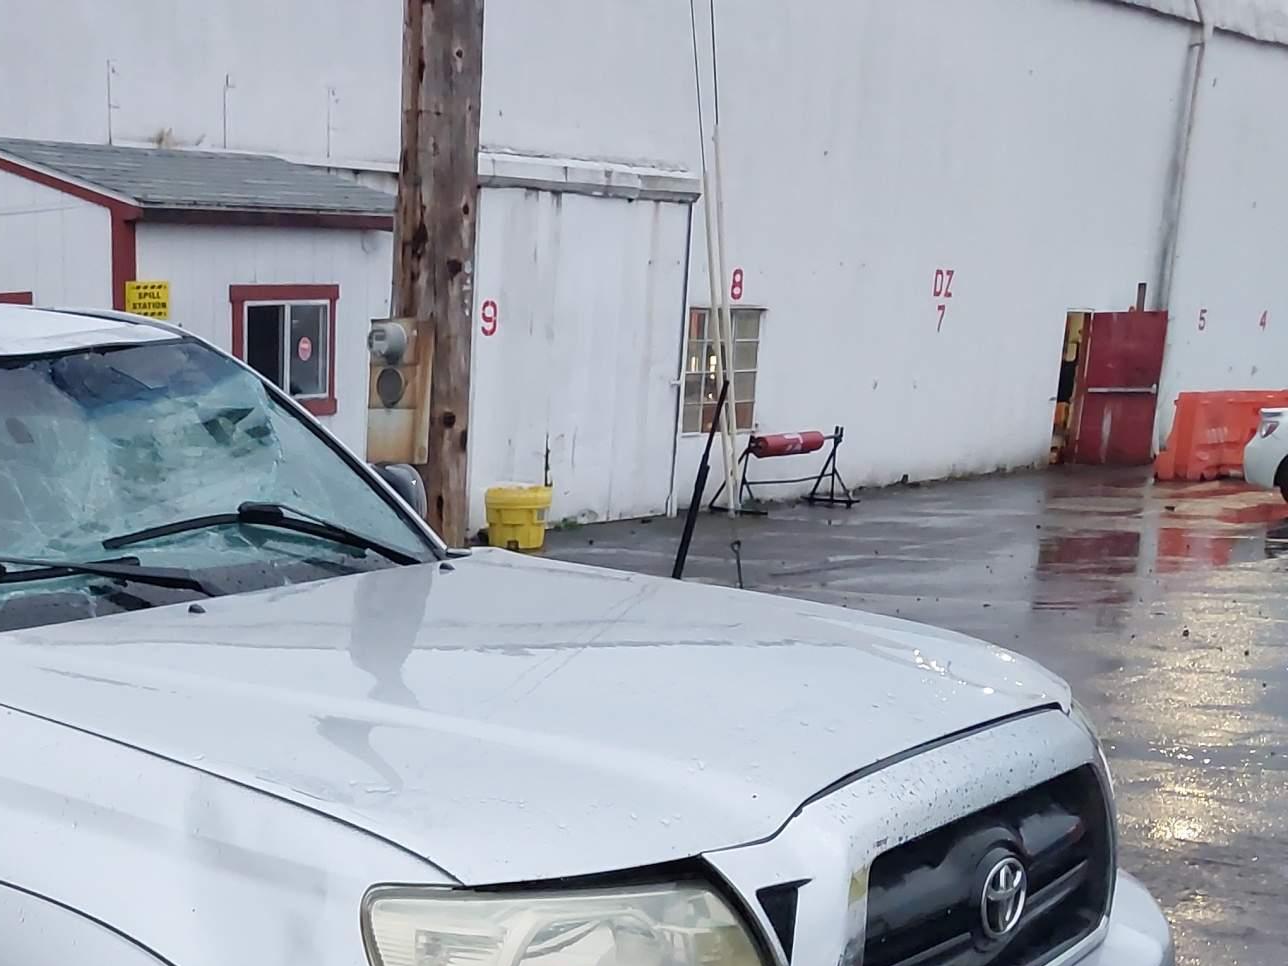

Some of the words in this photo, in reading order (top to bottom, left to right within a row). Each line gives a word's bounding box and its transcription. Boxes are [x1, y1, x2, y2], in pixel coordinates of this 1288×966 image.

[138, 291, 161, 300] SPILL
[731, 268, 743, 300] 8
[933, 269, 954, 298] DZ
[132, 302, 167, 310] STATION
[481, 300, 498, 337] 9
[937, 304, 946, 333] 7
[1198, 308, 1208, 331] 5
[1259, 309, 1268, 332] 4
